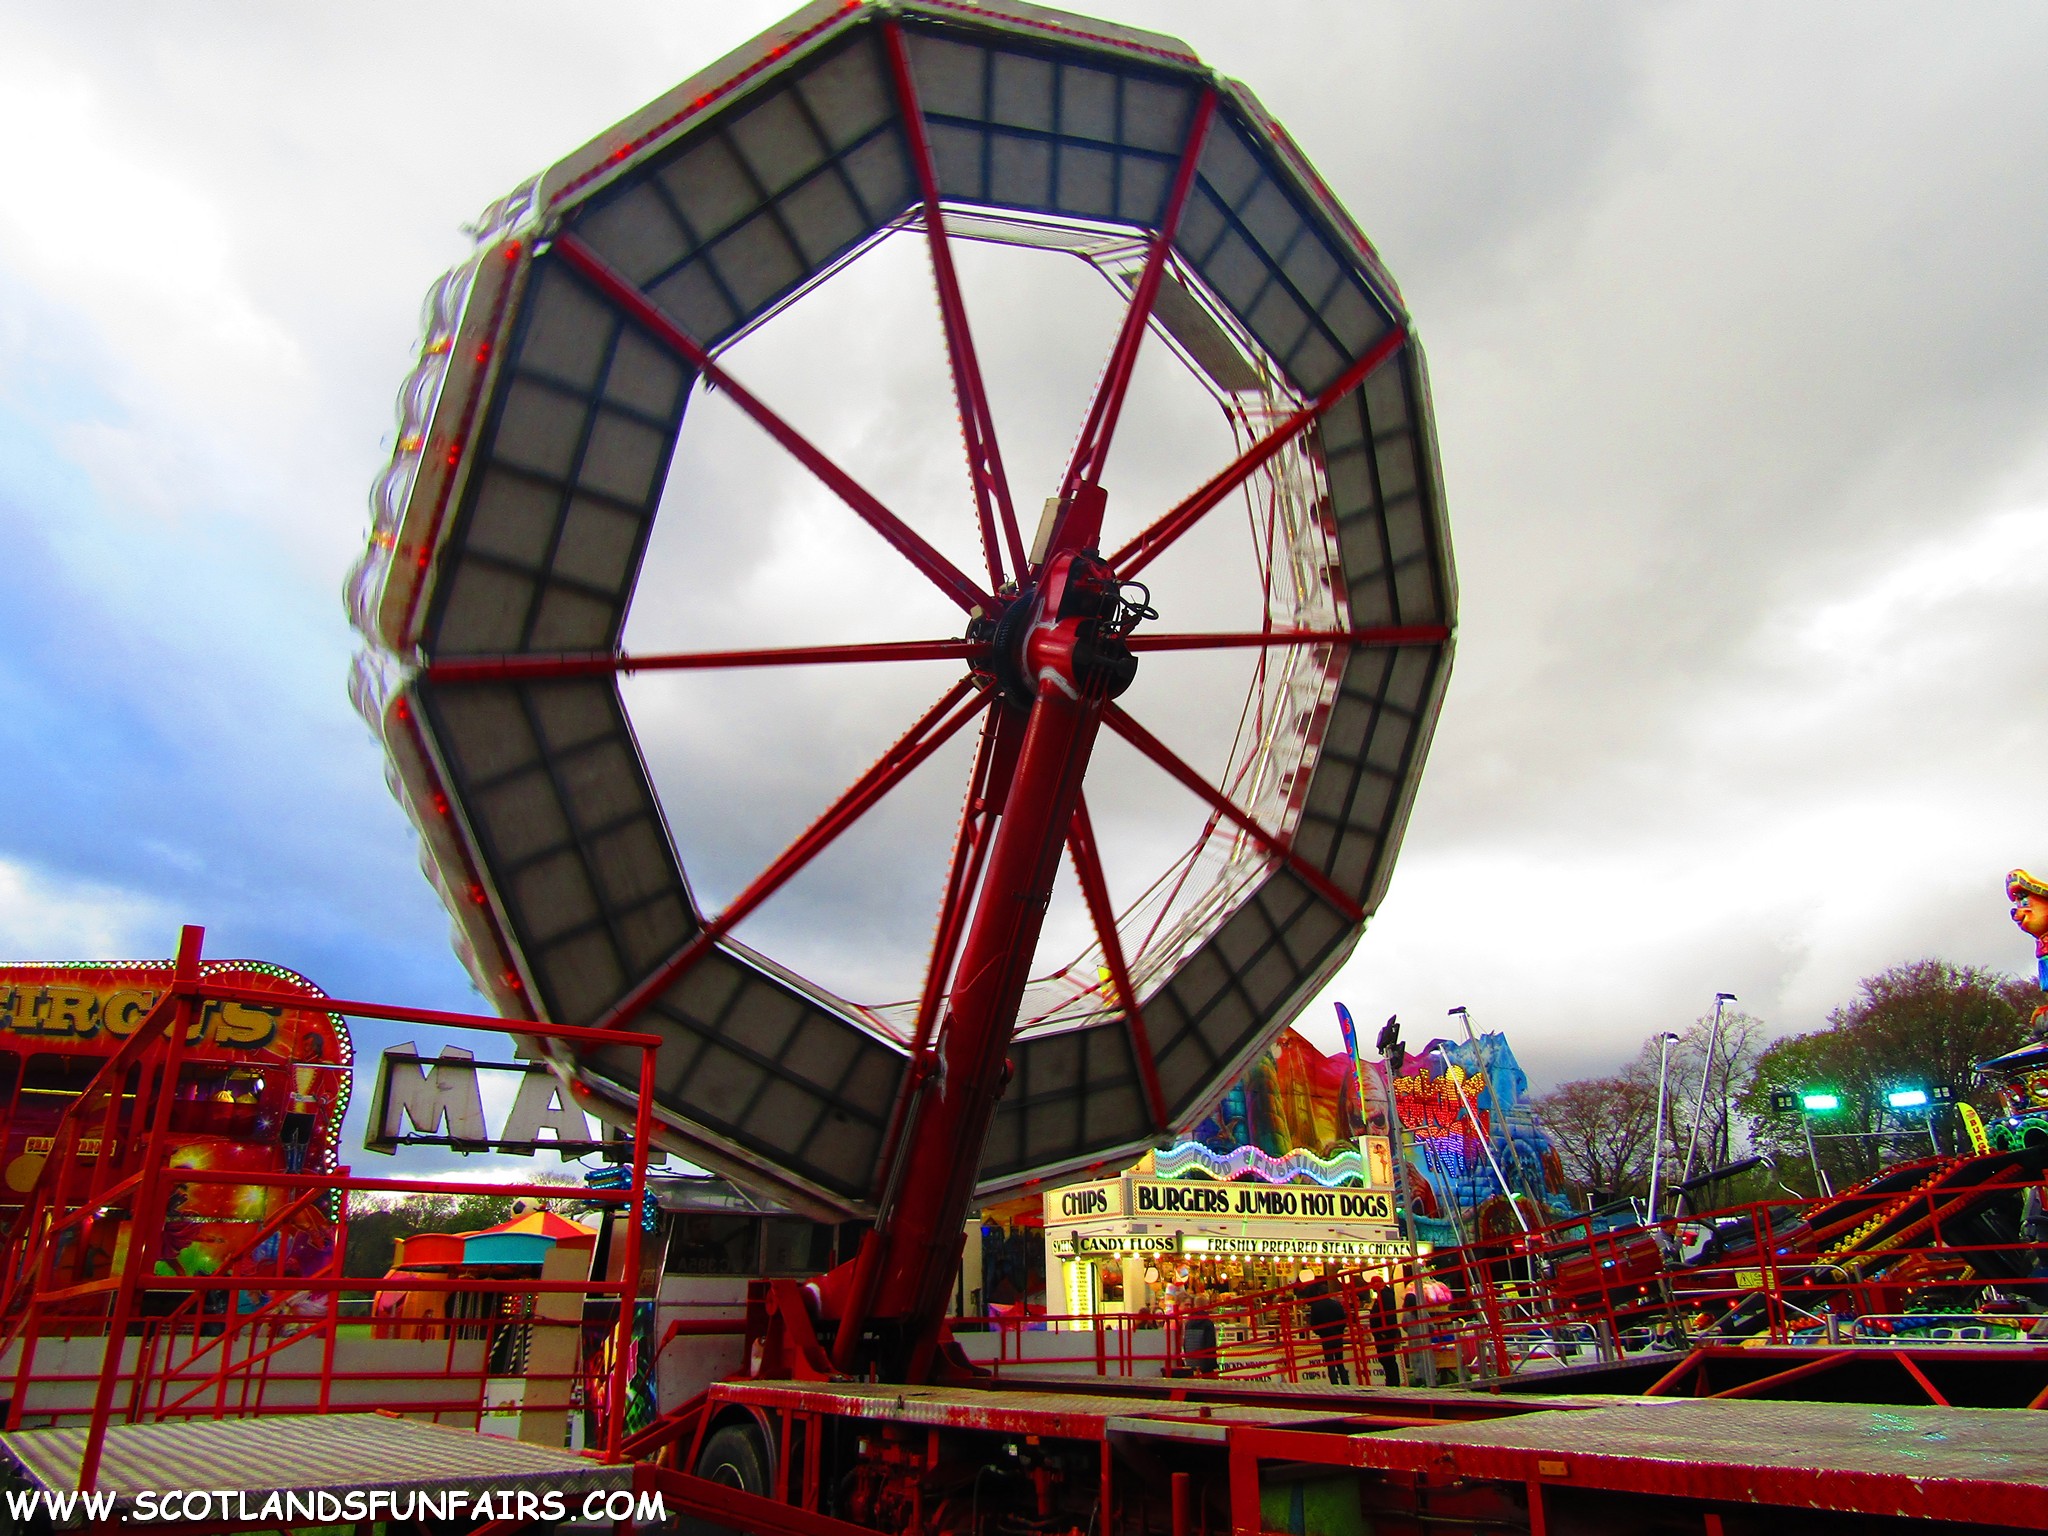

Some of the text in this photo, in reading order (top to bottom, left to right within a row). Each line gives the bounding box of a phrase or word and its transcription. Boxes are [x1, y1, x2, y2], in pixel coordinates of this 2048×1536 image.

[0, 985, 279, 1046] IRCUS
[1193, 1146, 1329, 1181] FOOD SENSATION
[1062, 1187, 1108, 1217] CHIPS
[1138, 1185, 1389, 1218] BURGERS JUMBO HOT DOGS
[1080, 1237, 1174, 1251] CANDY FLOSS
[1208, 1238, 1411, 1256] FRESHLY PREPARED STEAK & CHICKEN
